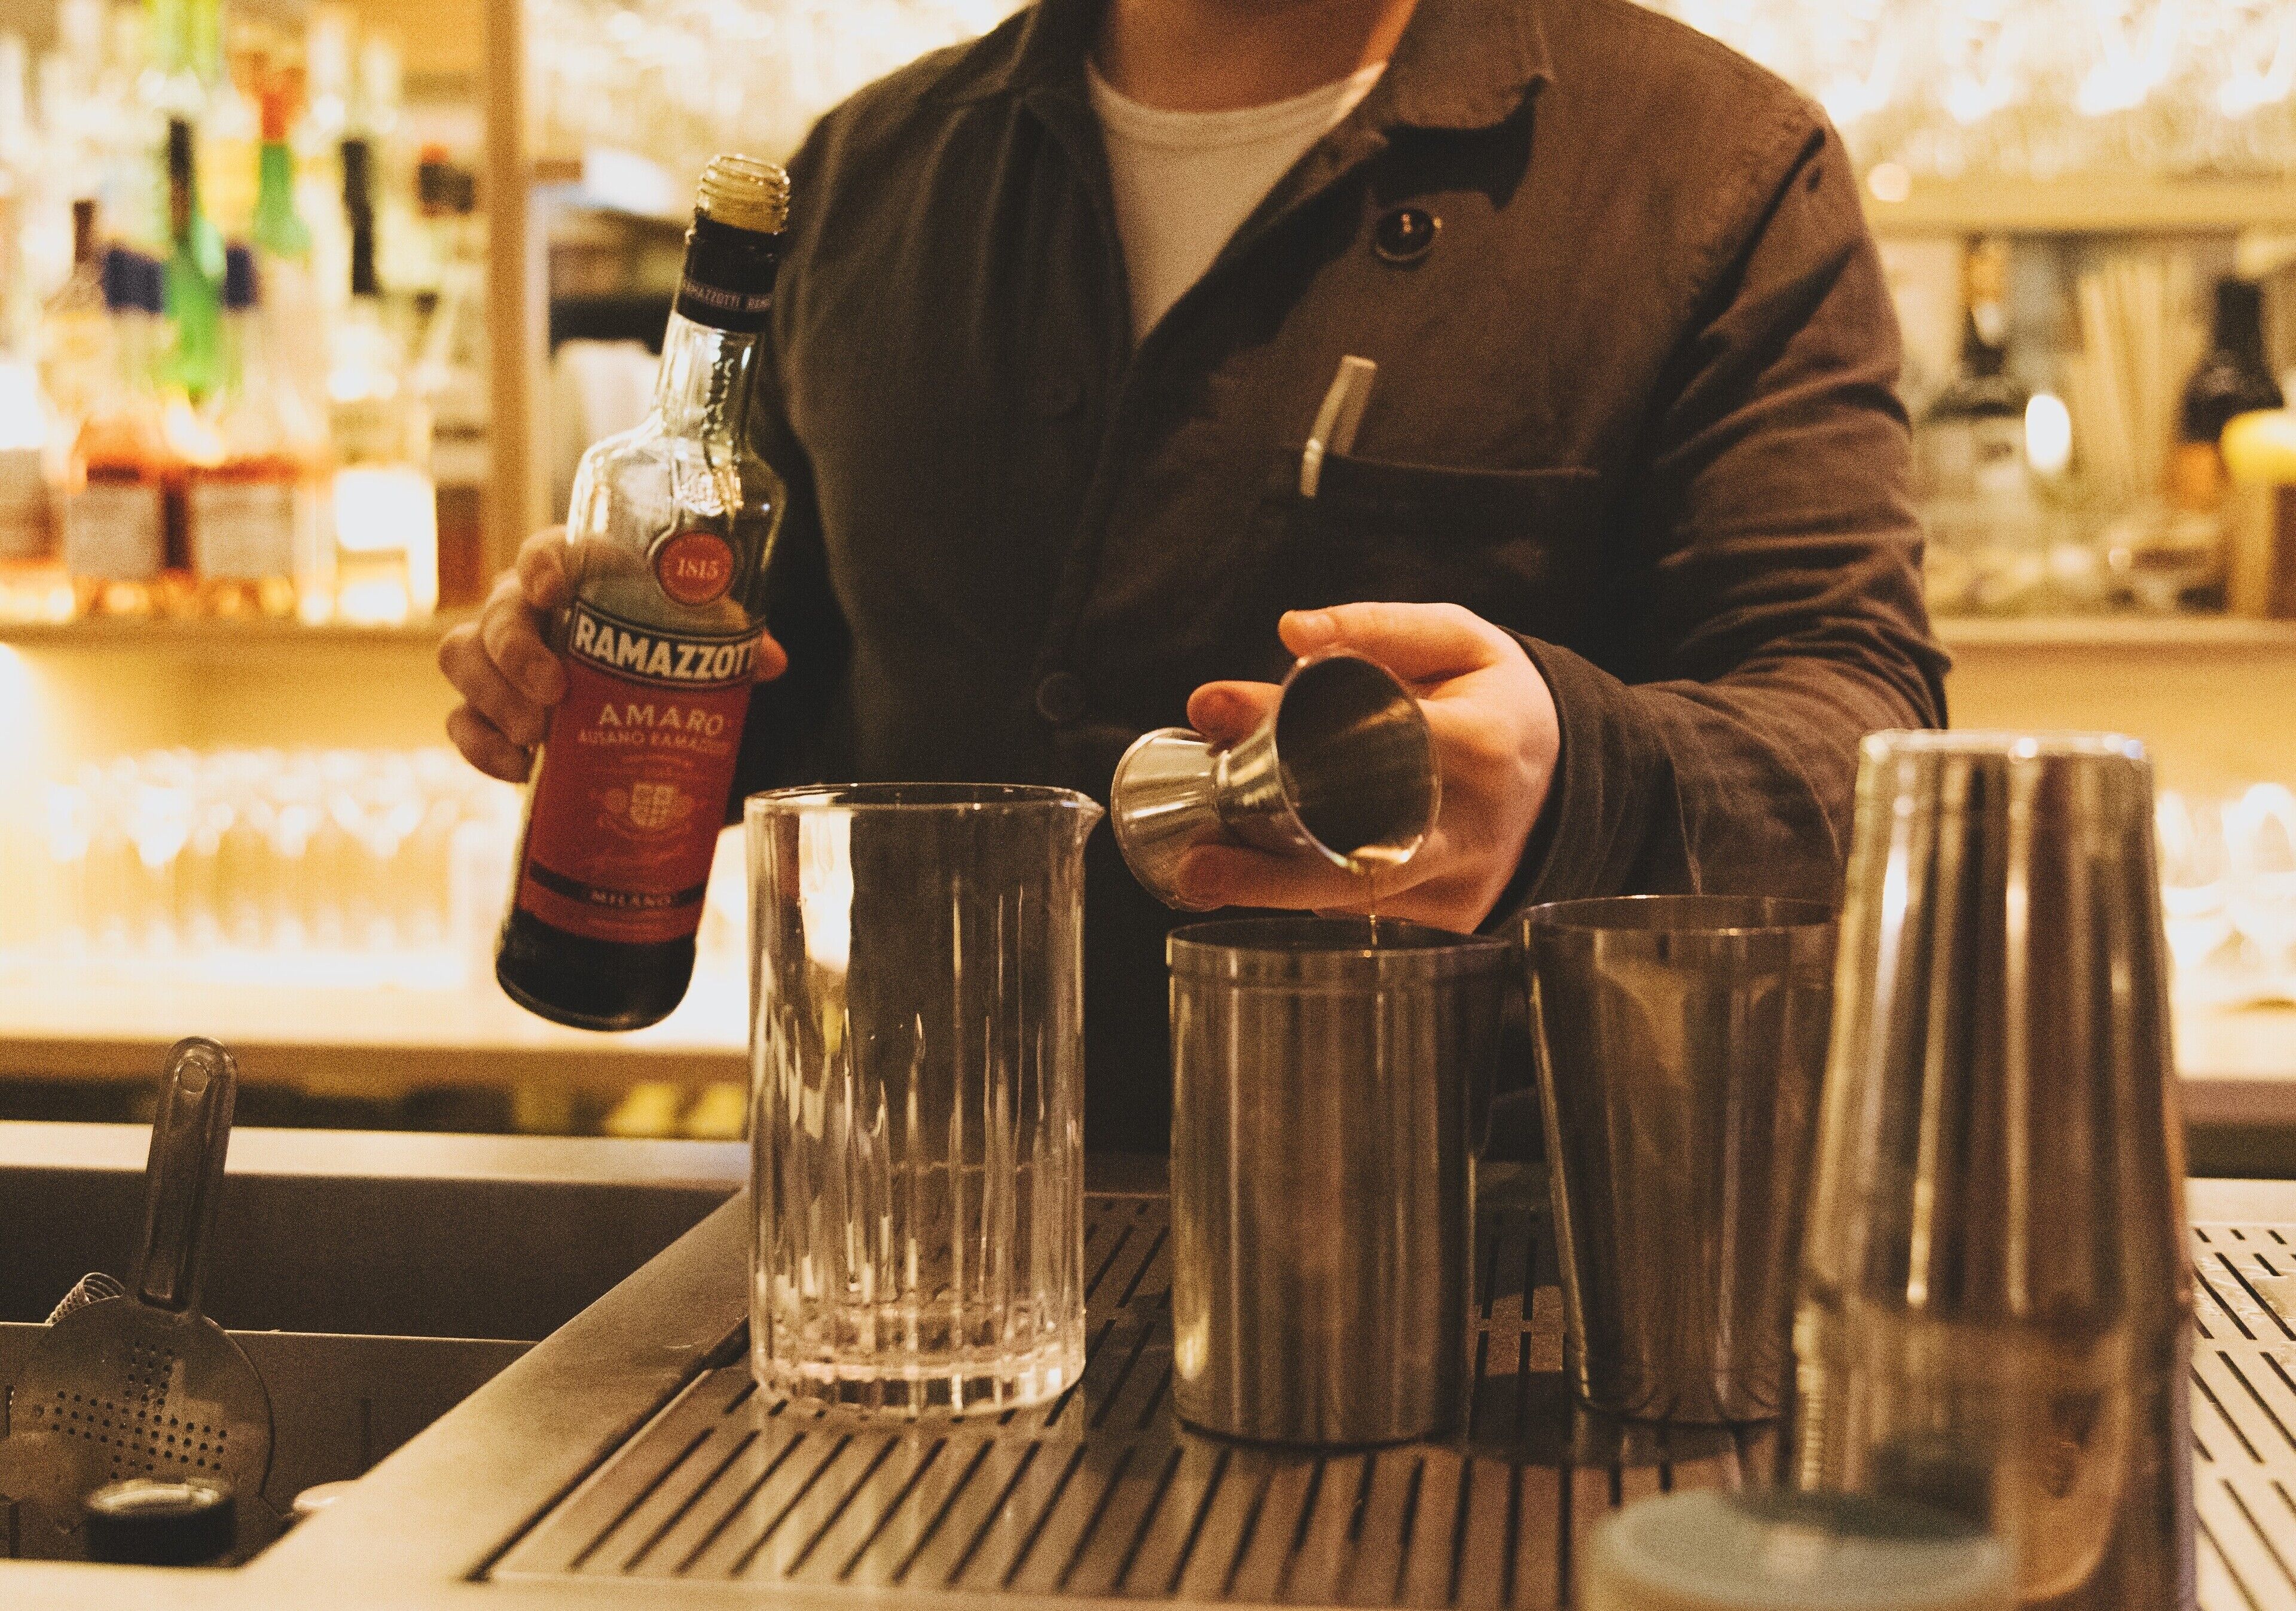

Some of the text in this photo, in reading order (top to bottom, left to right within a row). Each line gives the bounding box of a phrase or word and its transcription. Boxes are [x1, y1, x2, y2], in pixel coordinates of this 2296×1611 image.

[676, 557, 719, 580] 1815
[575, 614, 757, 680] RAMAZZOTT
[599, 703, 725, 737] AMARO
